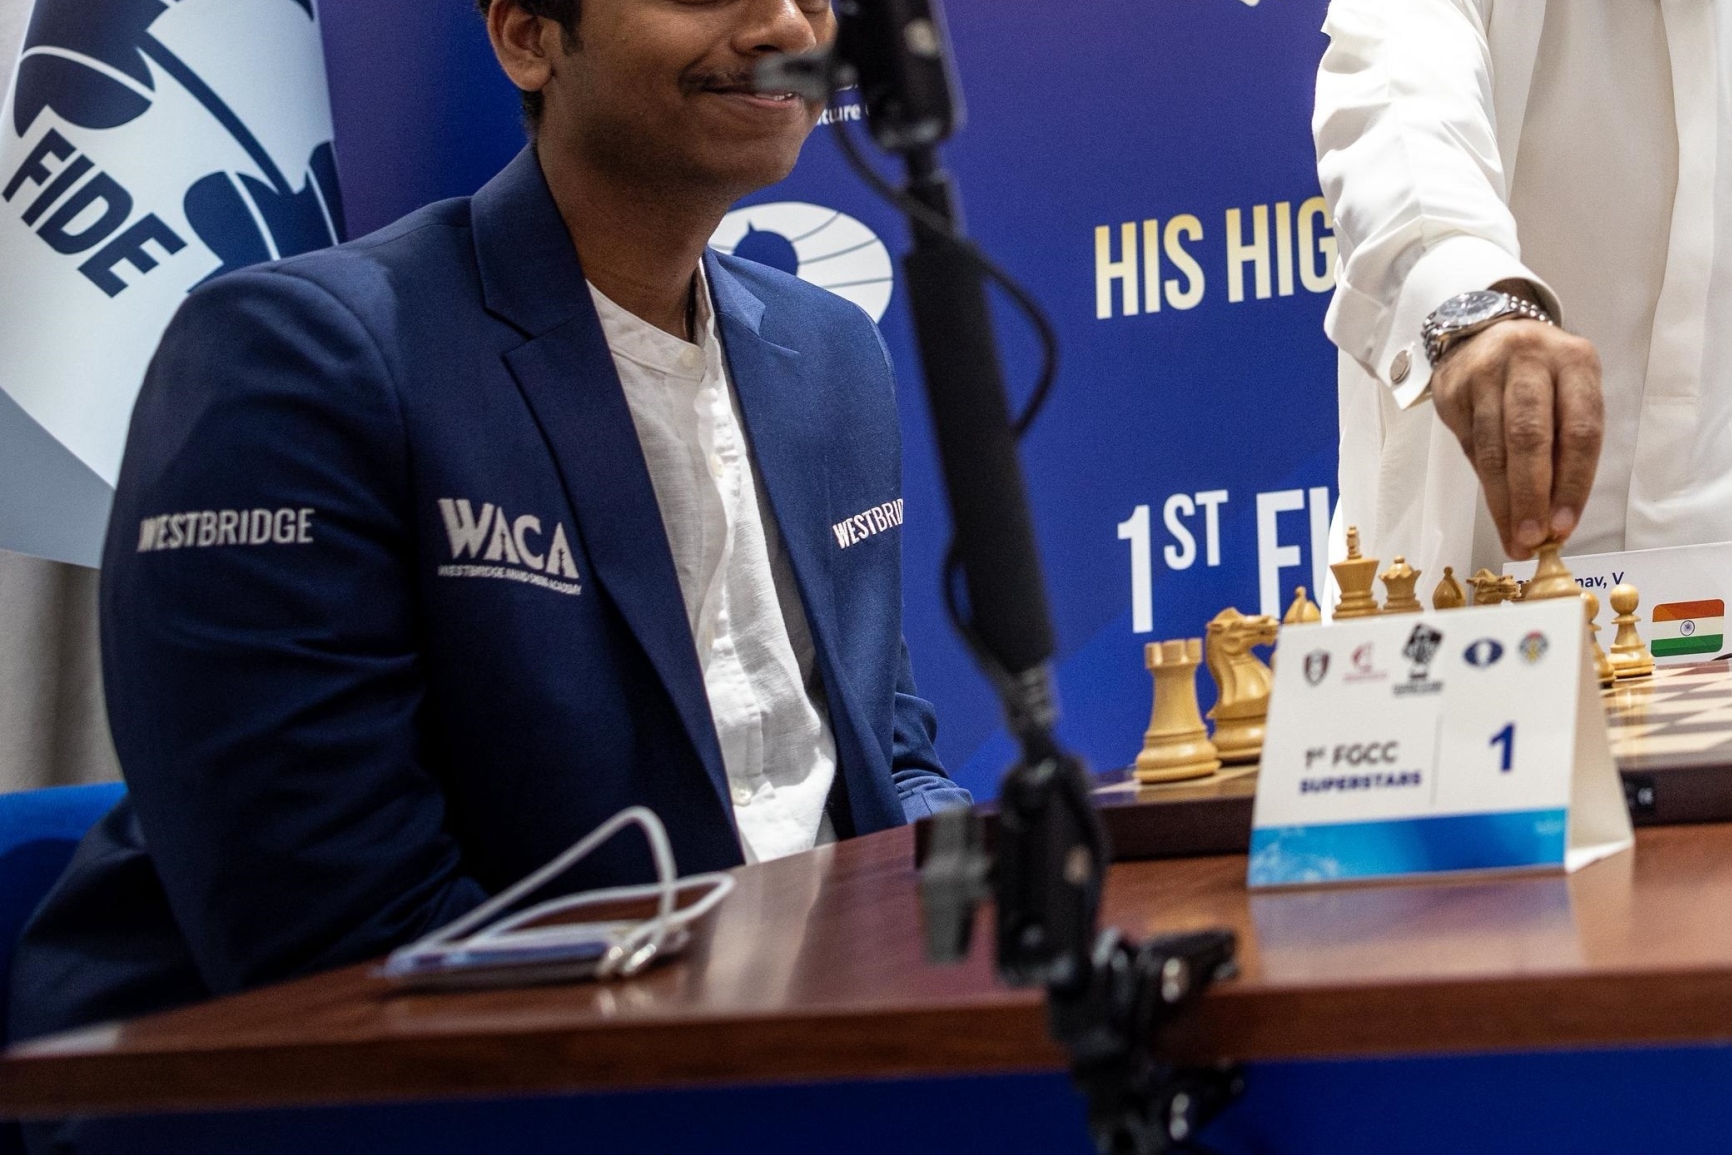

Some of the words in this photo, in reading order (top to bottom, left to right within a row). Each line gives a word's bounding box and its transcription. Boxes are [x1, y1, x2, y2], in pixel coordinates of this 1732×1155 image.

[816, 103, 861, 126] ture
[2, 127, 188, 298] FIDE
[1094, 213, 1206, 319] HIS
[137, 507, 316, 553] WESTBRIDGE
[437, 498, 580, 579] WACA
[1117, 489, 1229, 634] 1ST
[1612, 571, 1624, 585] V
[1332, 741, 1399, 767] FGCC
[1490, 722, 1516, 772] 1
[1300, 770, 1423, 794] SUPERSTARS
